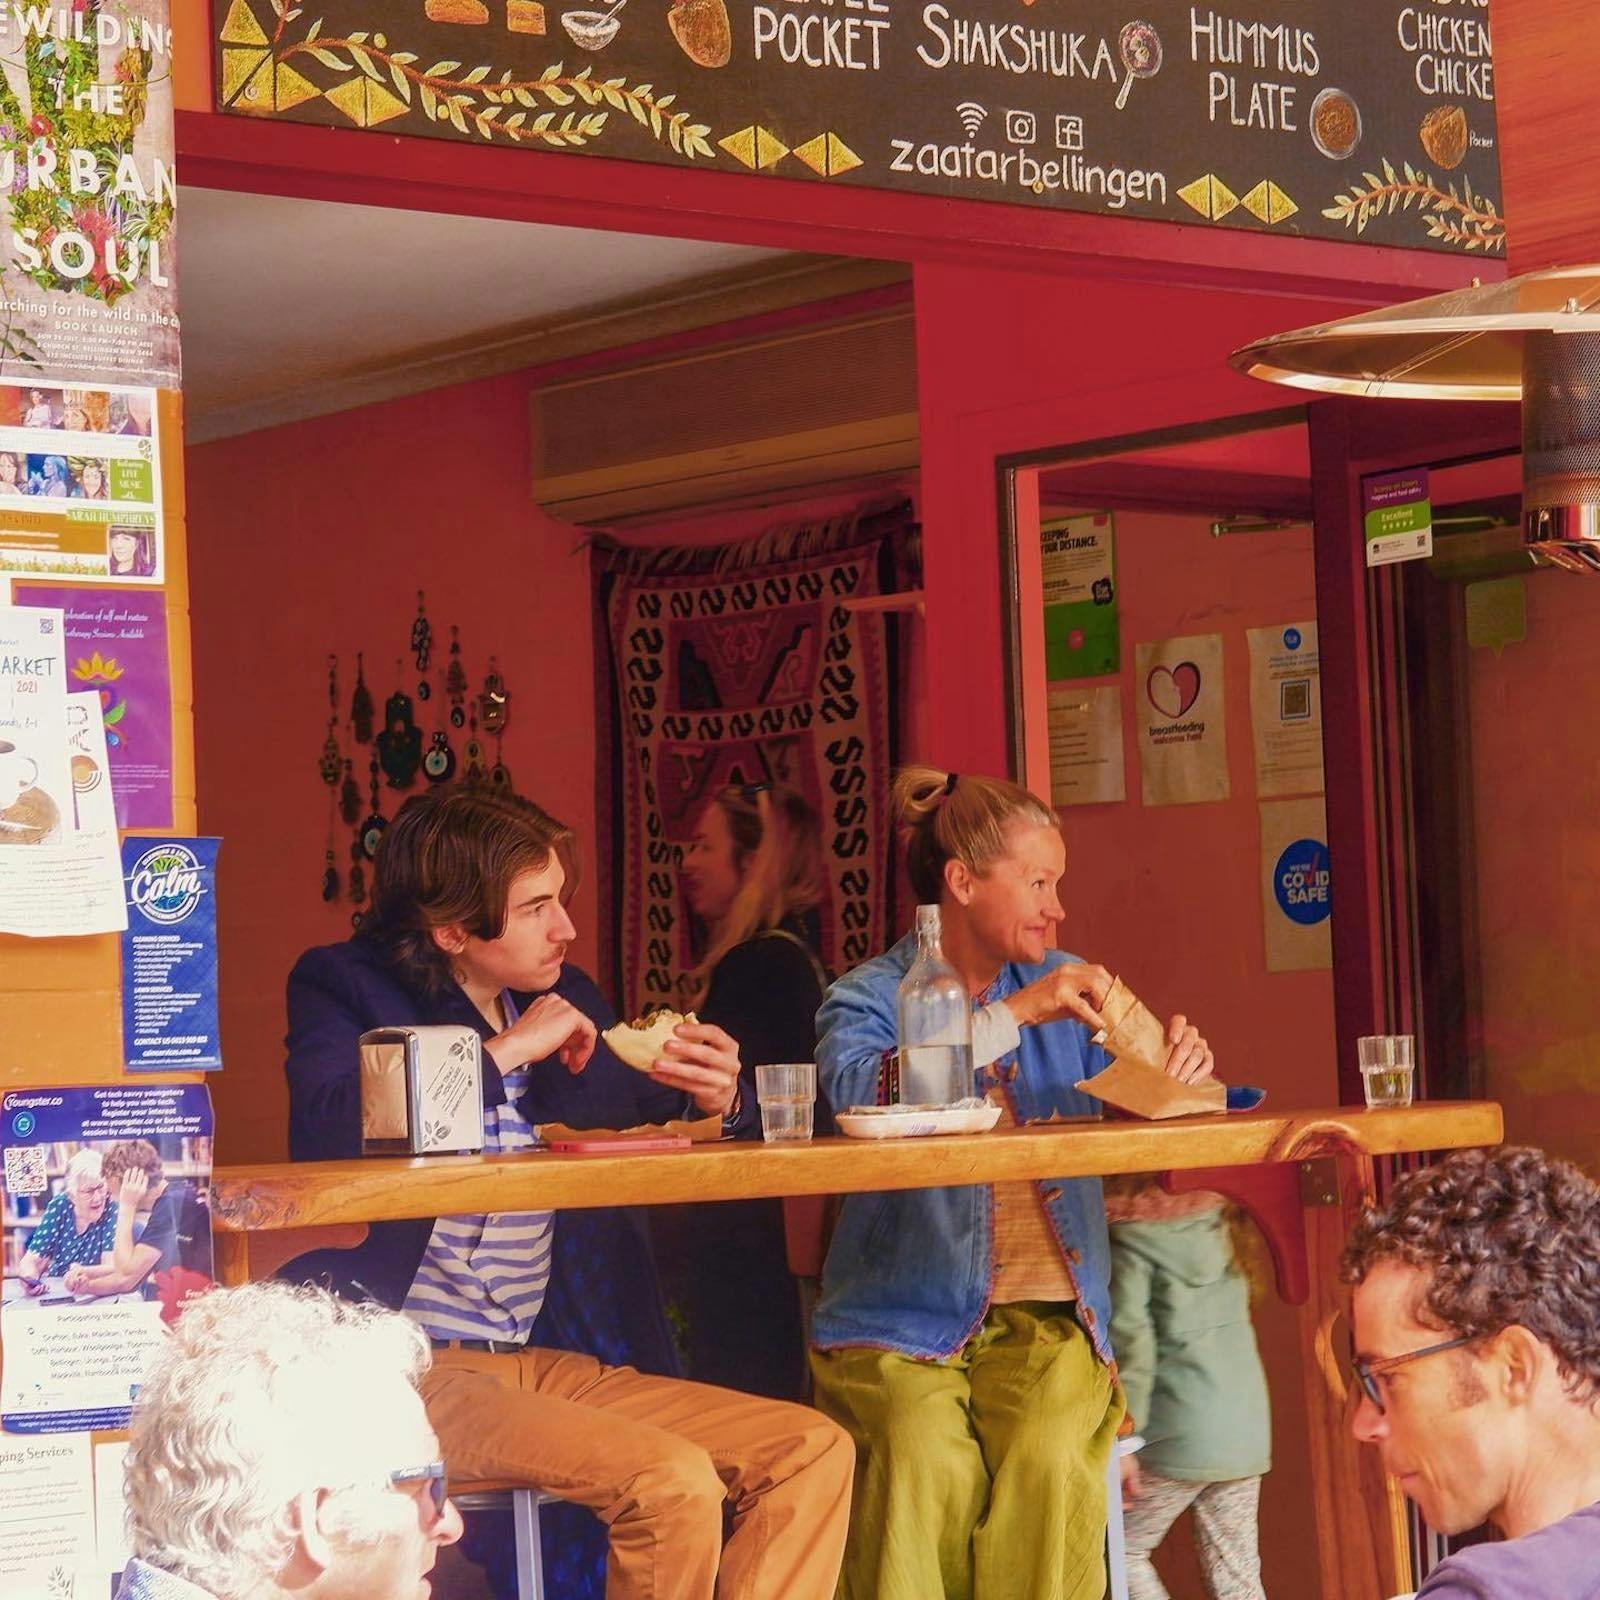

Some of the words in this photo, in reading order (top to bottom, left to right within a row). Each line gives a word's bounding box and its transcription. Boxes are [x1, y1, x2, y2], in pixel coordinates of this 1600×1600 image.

[753, 6, 891, 71] POCKET
[916, 3, 1118, 83] SHAKSHUKA
[1189, 6, 1321, 77] HUMMUS
[47, 74, 126, 117] THE
[1208, 70, 1298, 132] PLATE
[888, 138, 1168, 209] zaatarbellingen
[11, 227, 169, 288] SOUL
[53, 302, 71, 315] for
[78, 303, 98, 318] the
[103, 306, 132, 321] wild
[136, 311, 150, 324] in
[152, 312, 169, 326] the
[92, 323, 139, 336] LAUNCH
[2, 655, 57, 676] ARKET
[16, 680, 38, 693] 2021
[1149, 721, 1204, 737] breastfeeding
[131, 865, 201, 904] Calm
[1287, 886, 1328, 905] SAFE
[26, 1446, 74, 1460] Services
